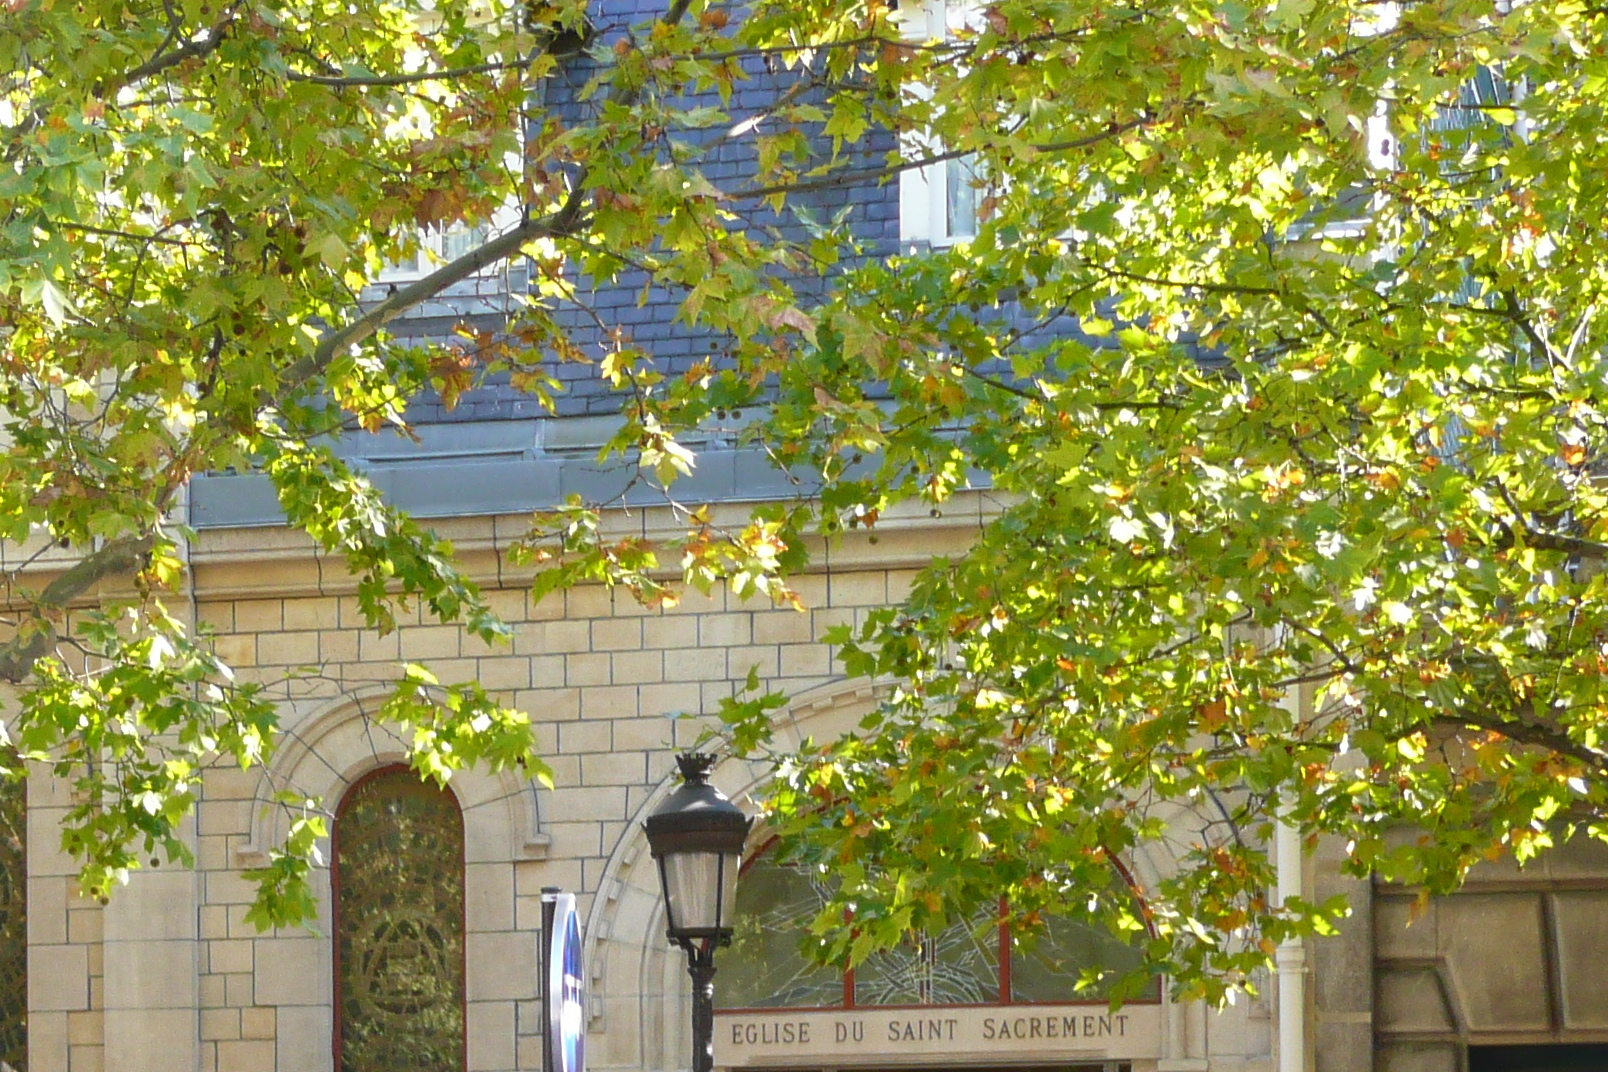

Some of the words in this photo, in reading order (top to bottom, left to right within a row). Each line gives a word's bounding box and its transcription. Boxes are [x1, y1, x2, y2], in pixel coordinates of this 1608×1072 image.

[731, 1021, 811, 1045] EGLISE
[834, 1021, 865, 1043] DU
[887, 1018, 959, 1042] SAINT
[982, 1014, 1130, 1041] SACREMENT
